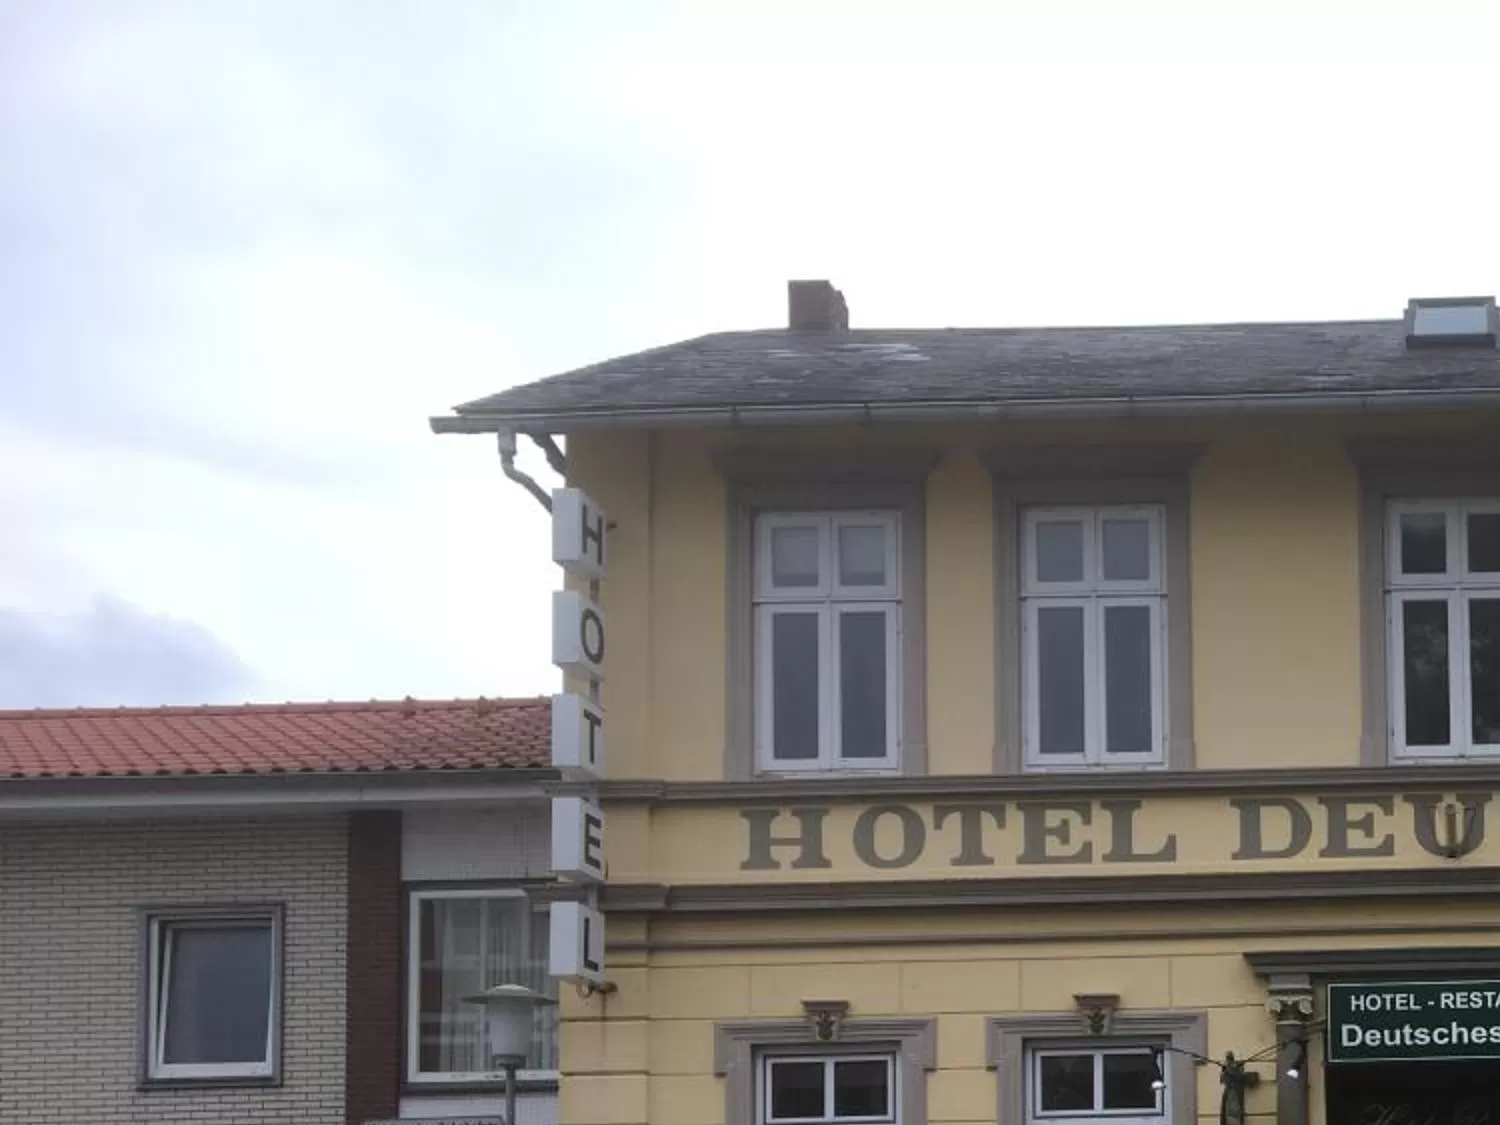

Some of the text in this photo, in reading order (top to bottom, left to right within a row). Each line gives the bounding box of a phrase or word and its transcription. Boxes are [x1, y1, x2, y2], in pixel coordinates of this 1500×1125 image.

[581, 503, 604, 973] HOTEL
[739, 800, 1177, 871] HOTEL
[1350, 993, 1422, 1012] HOTEL
